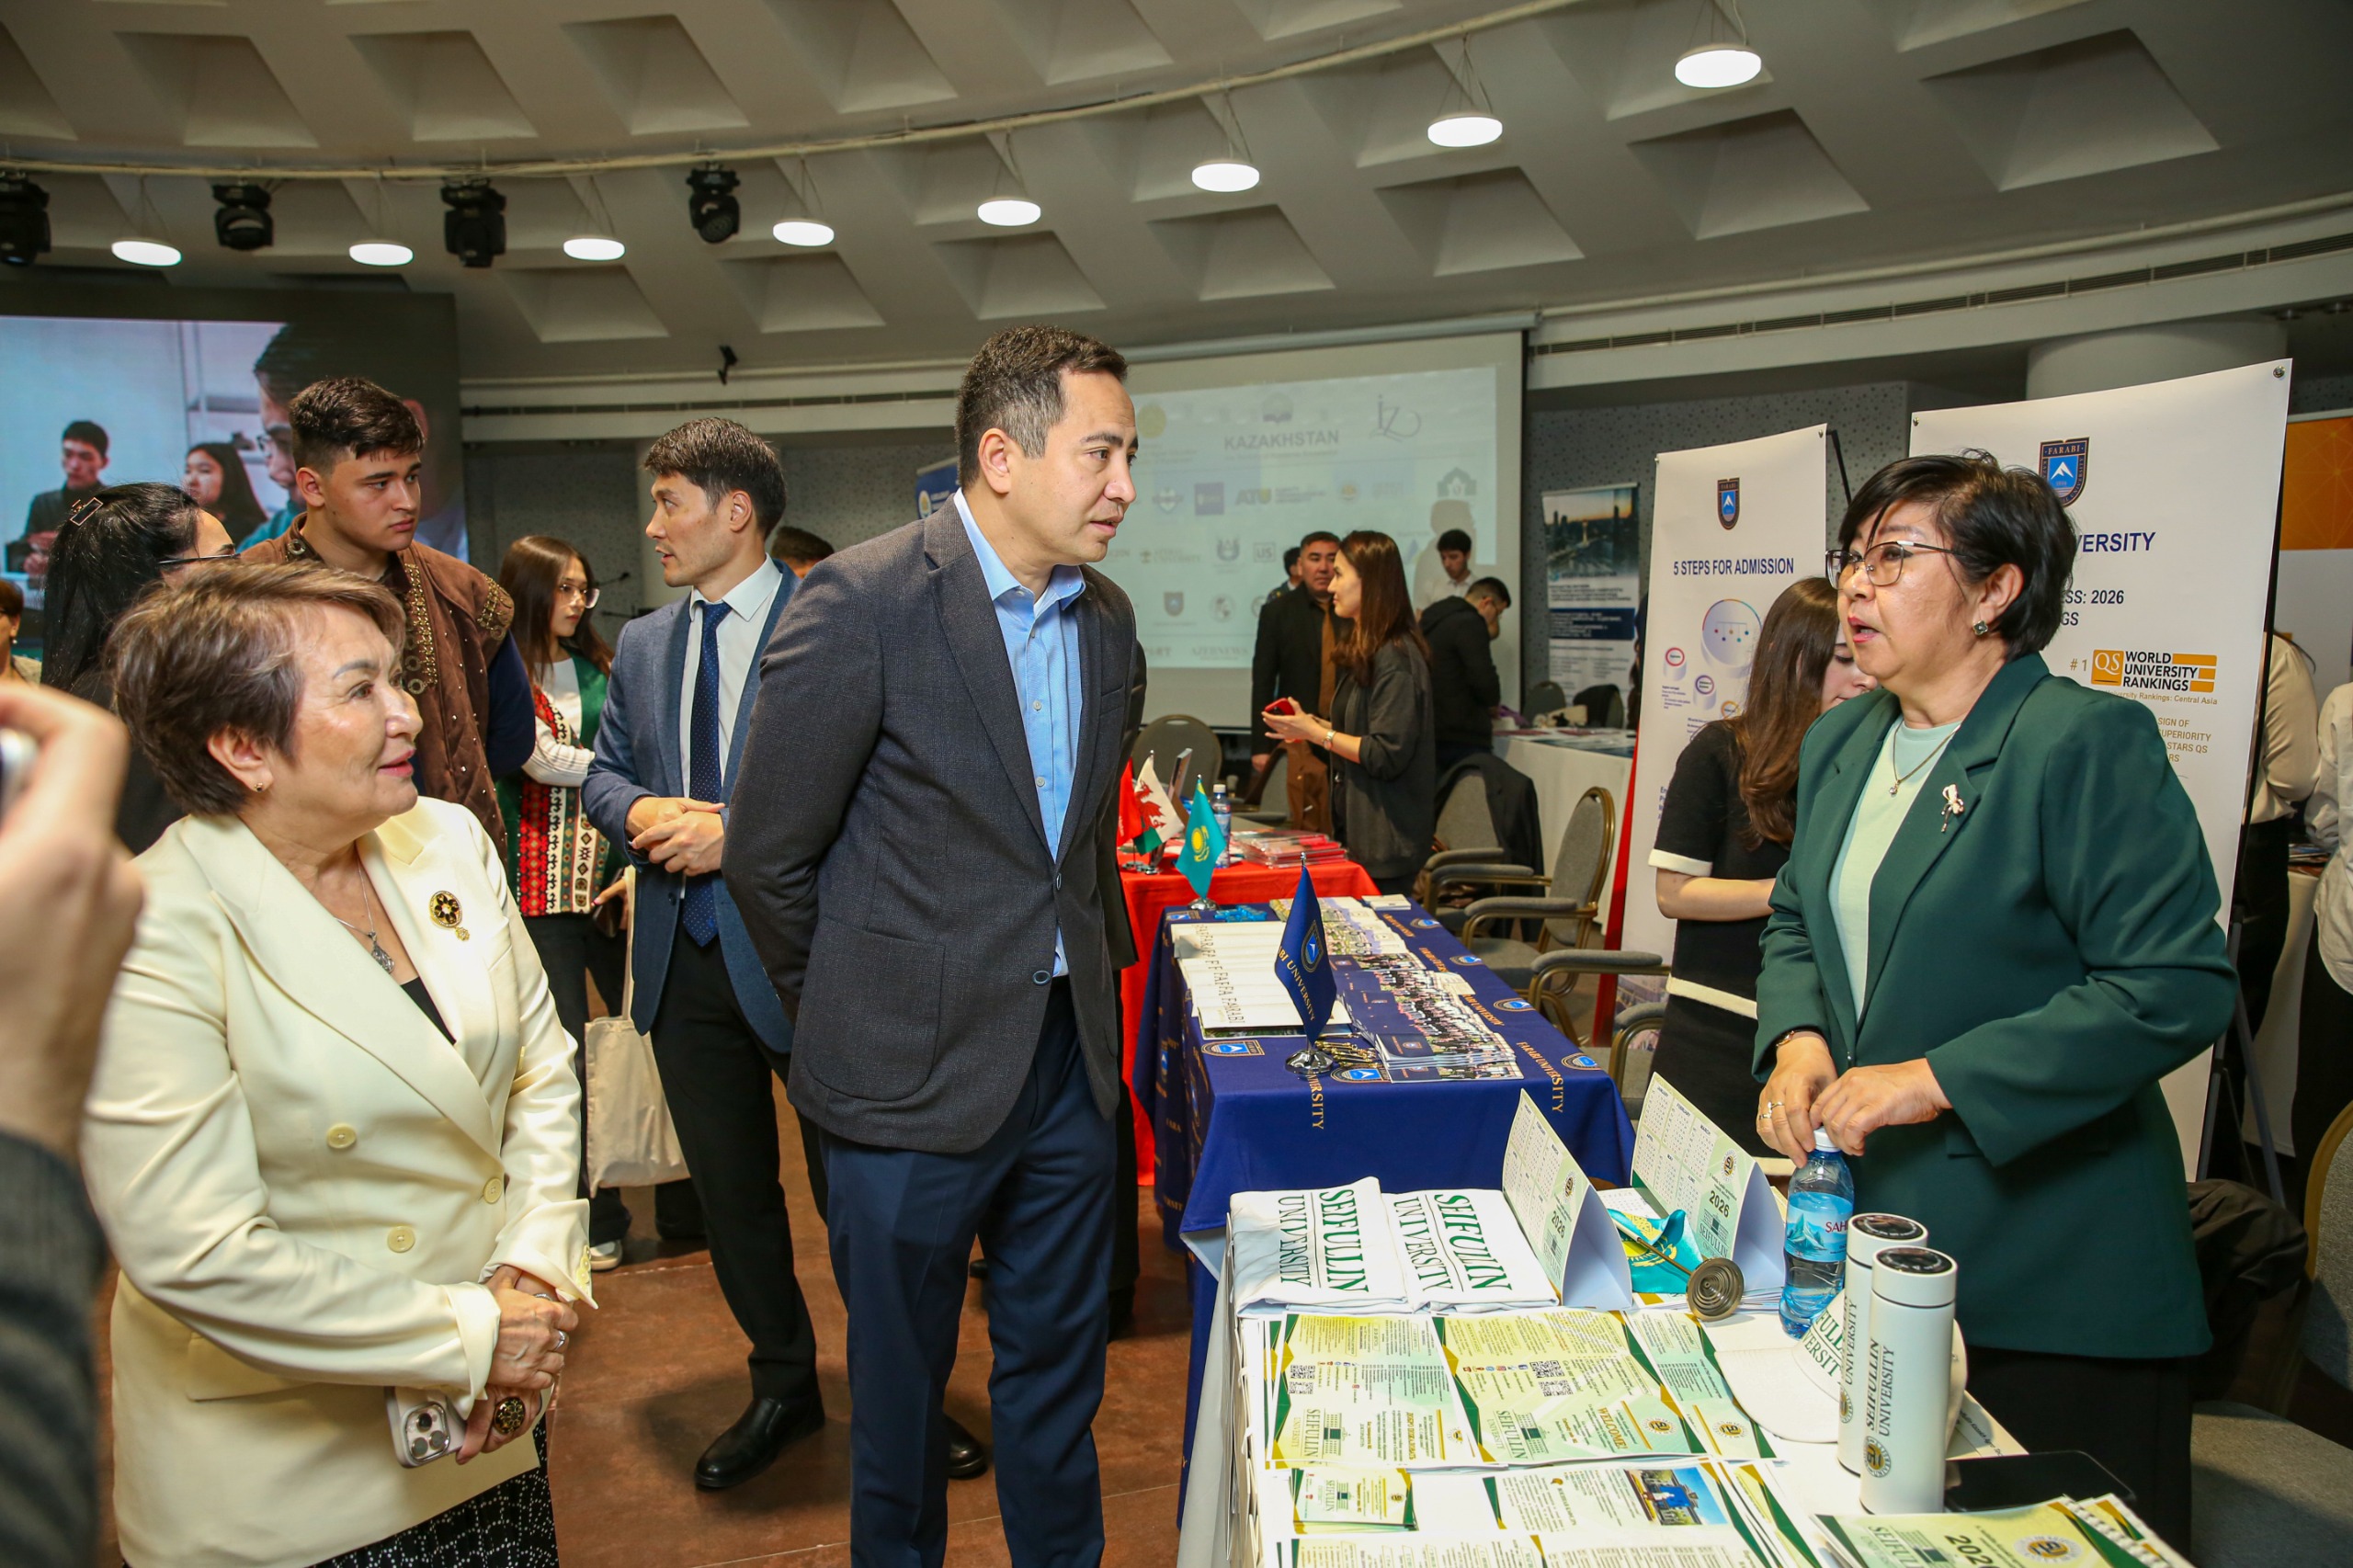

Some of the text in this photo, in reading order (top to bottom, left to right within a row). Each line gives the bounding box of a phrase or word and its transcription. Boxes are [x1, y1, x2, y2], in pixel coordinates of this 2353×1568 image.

[1224, 429, 1339, 450] KAZAKHSTAN
[2048, 445, 2081, 455] FARABI
[2078, 531, 2156, 552] ERSITY
[1674, 557, 1794, 575] 5 STEPS FOR ADMISSION
[2091, 589, 2124, 604] 2026
[2082, 659, 2087, 671] 1
[2095, 652, 2120, 676] QS
[2124, 664, 2198, 679] UNIVERSITY
[2125, 651, 2172, 665] WORLD
[2123, 676, 2188, 692] RANKINGS
[2139, 692, 2173, 702] Rankings:
[2174, 695, 2200, 704] Central
[2200, 697, 2218, 705] Asia
[2158, 717, 2189, 728] SIGN OF
[2166, 742, 2208, 754] STARS QS
[1287, 960, 1315, 1021] UNIVERSITY
[1516, 1041, 1564, 1113] FARABI UNIVERSITY
[1709, 1190, 1730, 1218] 2026
[1278, 1195, 1312, 1288] UNIVERSITY
[1319, 1188, 1370, 1292] SEIFULLIN
[1393, 1197, 1454, 1291] UNIVERSITY
[1434, 1194, 1513, 1291] SEIFULLIN
[1699, 1222, 1728, 1258] SEIFULLIN
[1846, 1300, 1857, 1385] UNIVERSITY
[1865, 1338, 1880, 1431] SEIFULLIN
[1879, 1346, 1894, 1437] UNIVERSITY
[1304, 1408, 1321, 1458] SEIFULLIN
[1487, 1418, 1505, 1449] UNIVERSITY
[1496, 1410, 1529, 1460] SEIFULLIN
[1597, 1407, 1628, 1449] WELCOME!
